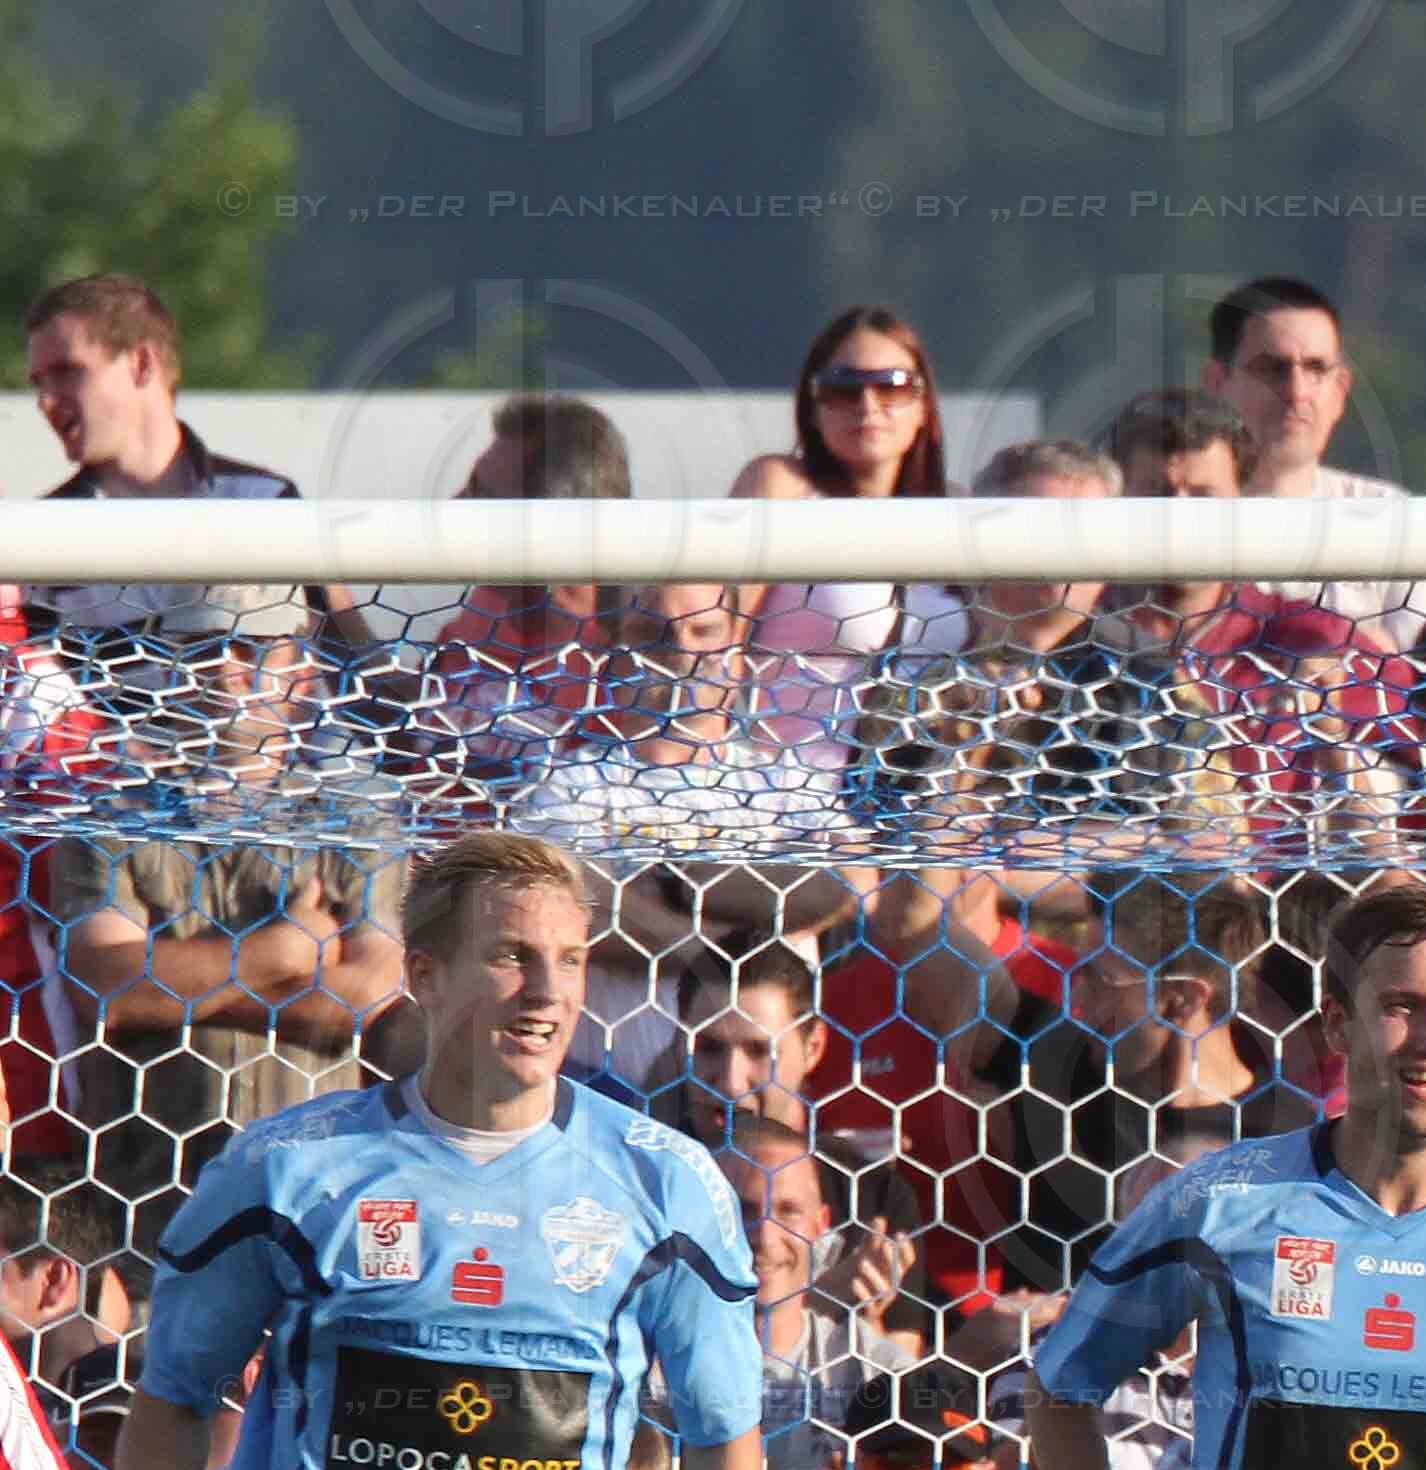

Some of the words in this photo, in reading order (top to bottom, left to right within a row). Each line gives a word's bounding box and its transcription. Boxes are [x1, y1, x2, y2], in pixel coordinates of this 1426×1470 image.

[364, 1262, 414, 1278] LIGA
[1379, 1260, 1426, 1277] JAKO
[1276, 1300, 1325, 1318] LIGA
